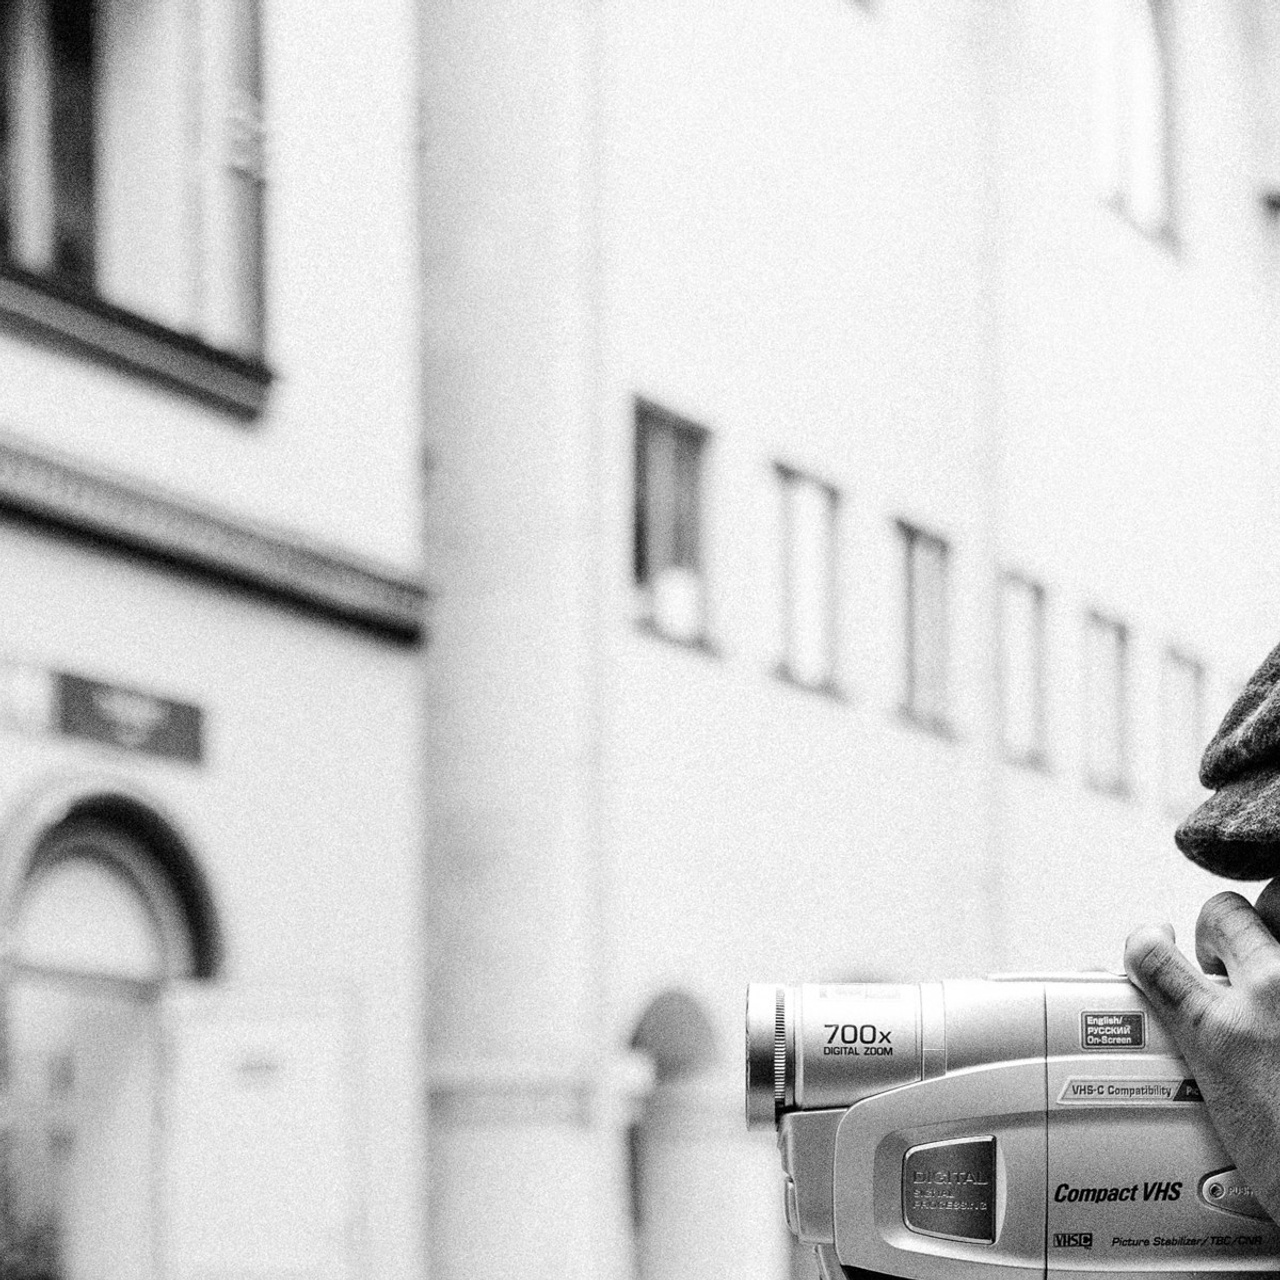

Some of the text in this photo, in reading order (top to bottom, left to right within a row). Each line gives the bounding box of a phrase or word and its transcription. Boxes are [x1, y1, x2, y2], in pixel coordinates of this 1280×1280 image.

[1087, 1016, 1123, 1026] English/
[824, 1024, 891, 1044] 700x
[1087, 1024, 1131, 1035] РУССКИЙ
[1087, 1035, 1132, 1044] On-Screen
[823, 1046, 893, 1056] DIGITAL ZOOM
[1072, 1084, 1172, 1098] VHS-C Compatibility
[913, 1170, 989, 1186] DIGITAL
[1054, 1182, 1183, 1204] Compact VHS
[1112, 1237, 1150, 1247] Picture
